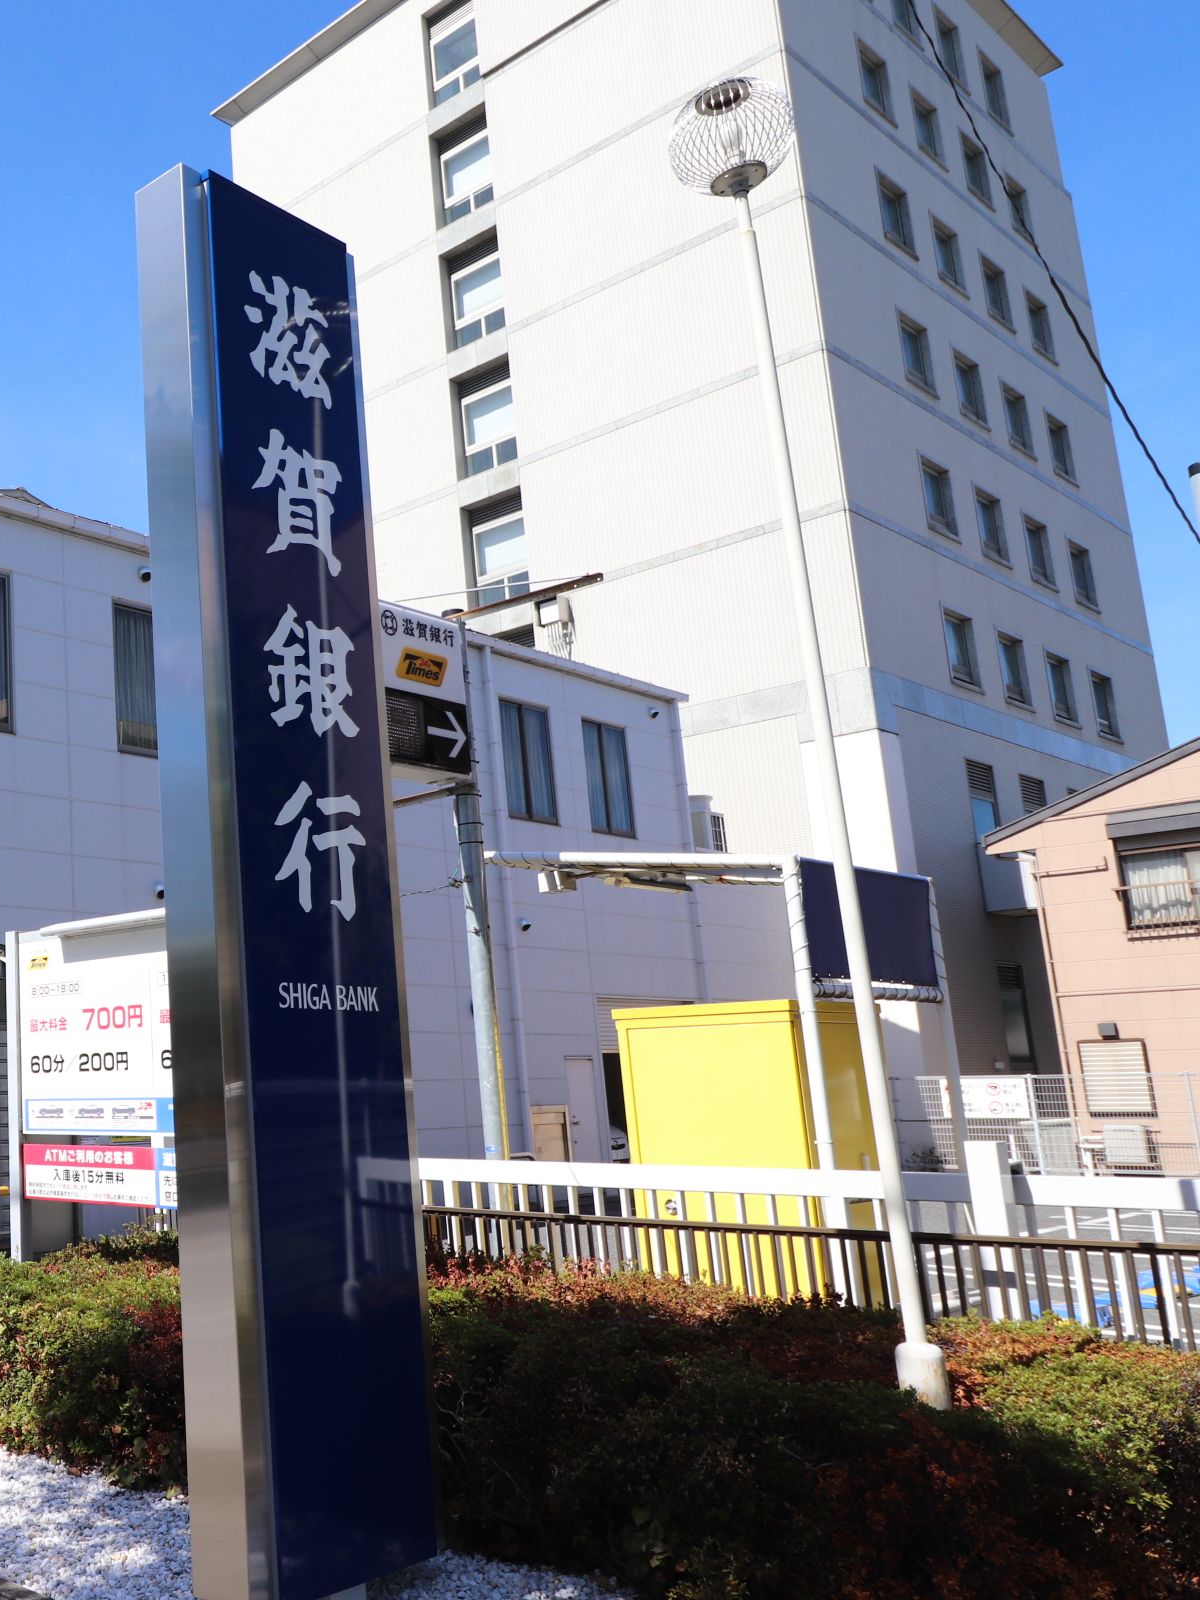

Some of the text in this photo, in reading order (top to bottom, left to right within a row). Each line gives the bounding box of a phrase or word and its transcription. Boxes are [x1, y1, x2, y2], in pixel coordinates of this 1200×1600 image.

[244, 270, 365, 921] 滋賀銀行
[402, 618, 454, 647] 滋賀銀行
[403, 654, 441, 681] Times
[279, 982, 379, 1012] SHIGA BANK
[30, 1004, 143, 1032] 最大料金 700円
[44, 1149, 134, 1165] ATMご利用のお客様
[53, 1168, 124, 1185] 入庫後15分無料
